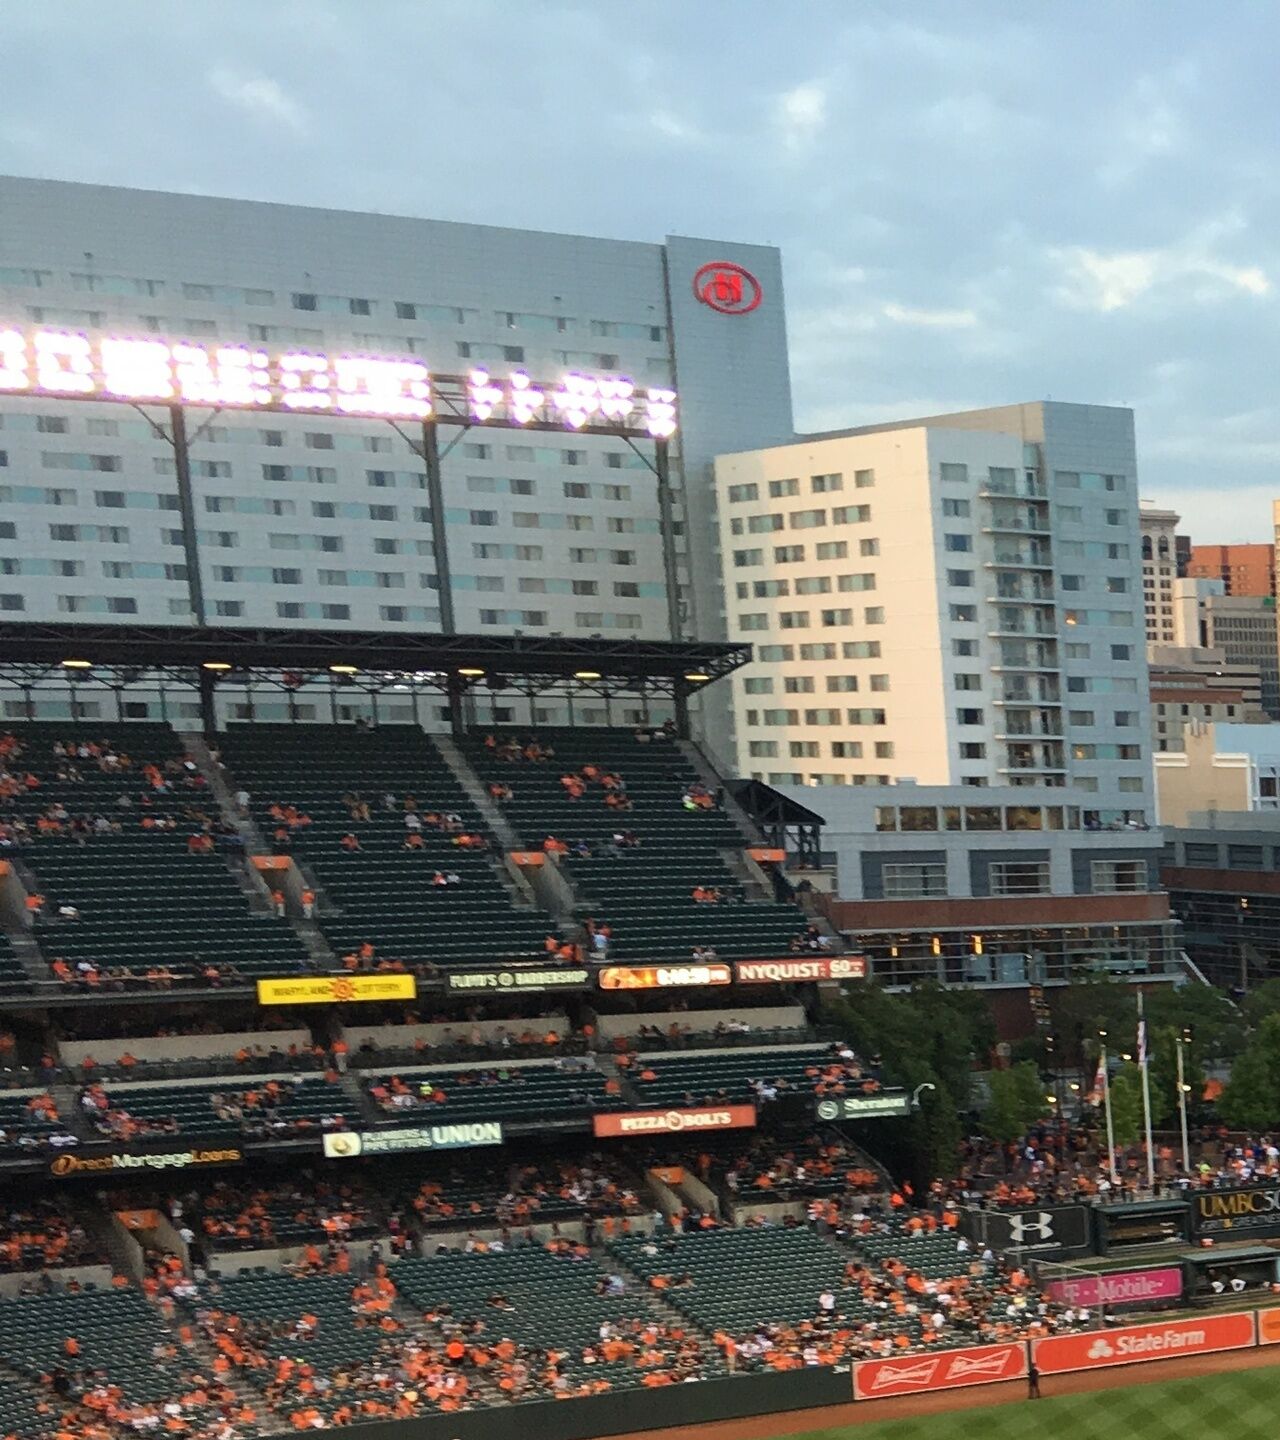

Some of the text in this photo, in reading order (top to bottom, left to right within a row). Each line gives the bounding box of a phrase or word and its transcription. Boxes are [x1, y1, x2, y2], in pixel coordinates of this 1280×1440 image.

[739, 961, 820, 982] NYQUIST
[431, 1122, 502, 1145] UNION
[620, 1115, 668, 1131] PIZZA
